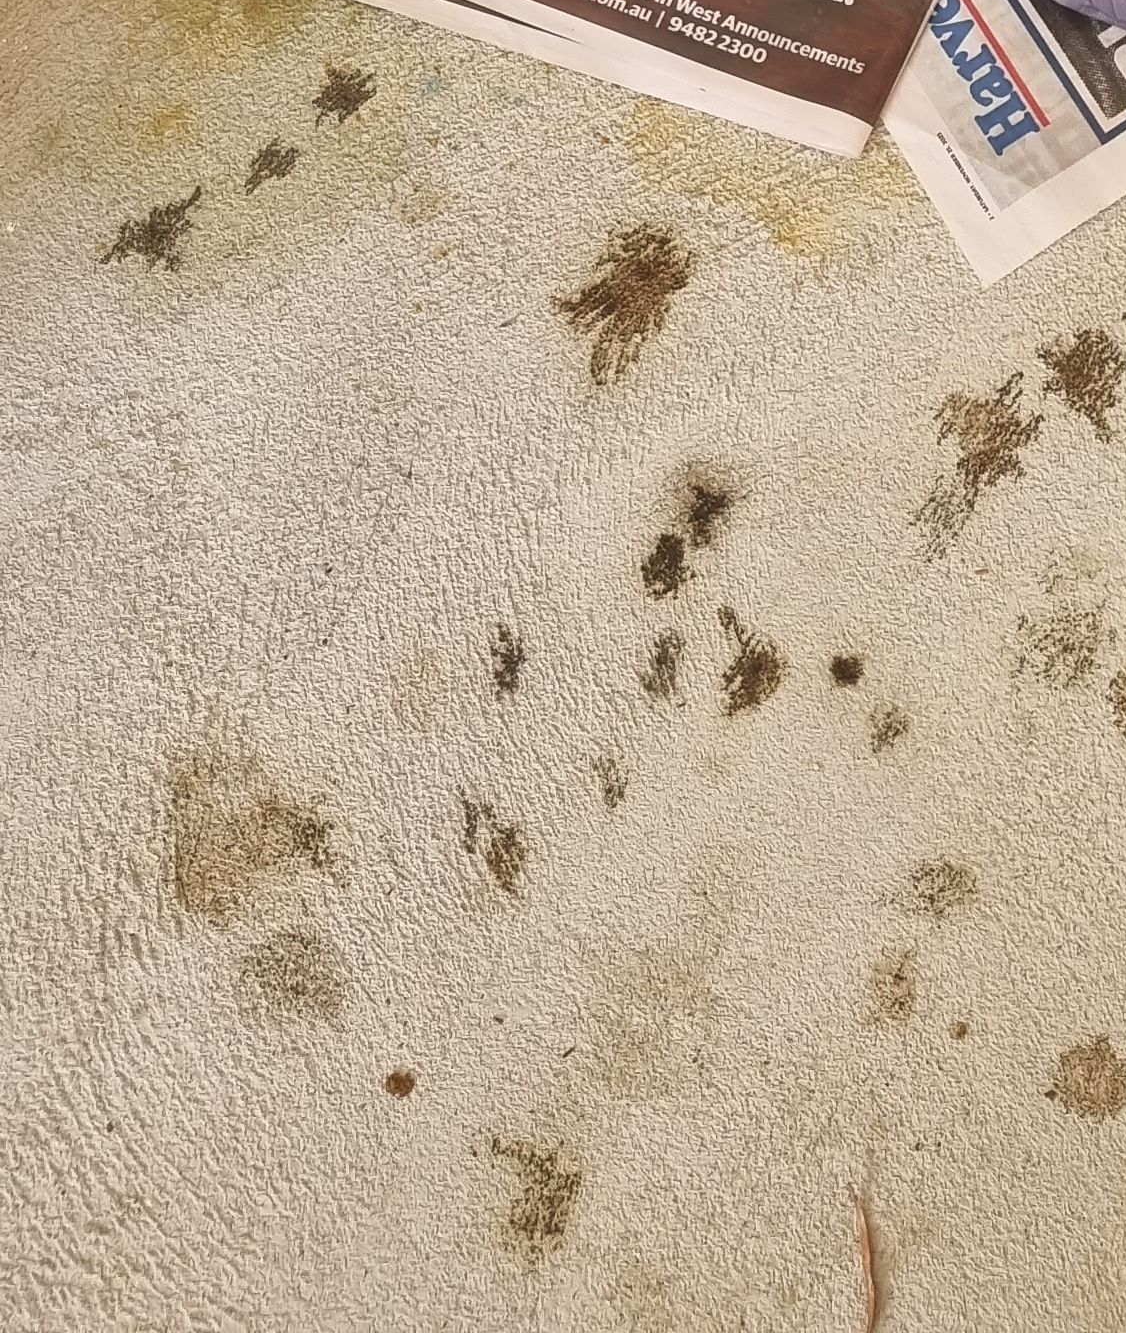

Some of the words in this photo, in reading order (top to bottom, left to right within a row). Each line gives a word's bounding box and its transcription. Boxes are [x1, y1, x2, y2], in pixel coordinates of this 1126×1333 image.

[666, 15, 720, 47] 9482
[716, 32, 769, 66] 2300
[720, 13, 867, 76] Announcements
[949, 152, 971, 184] NOVEMBER
[969, 183, 990, 213] SATURDAY
